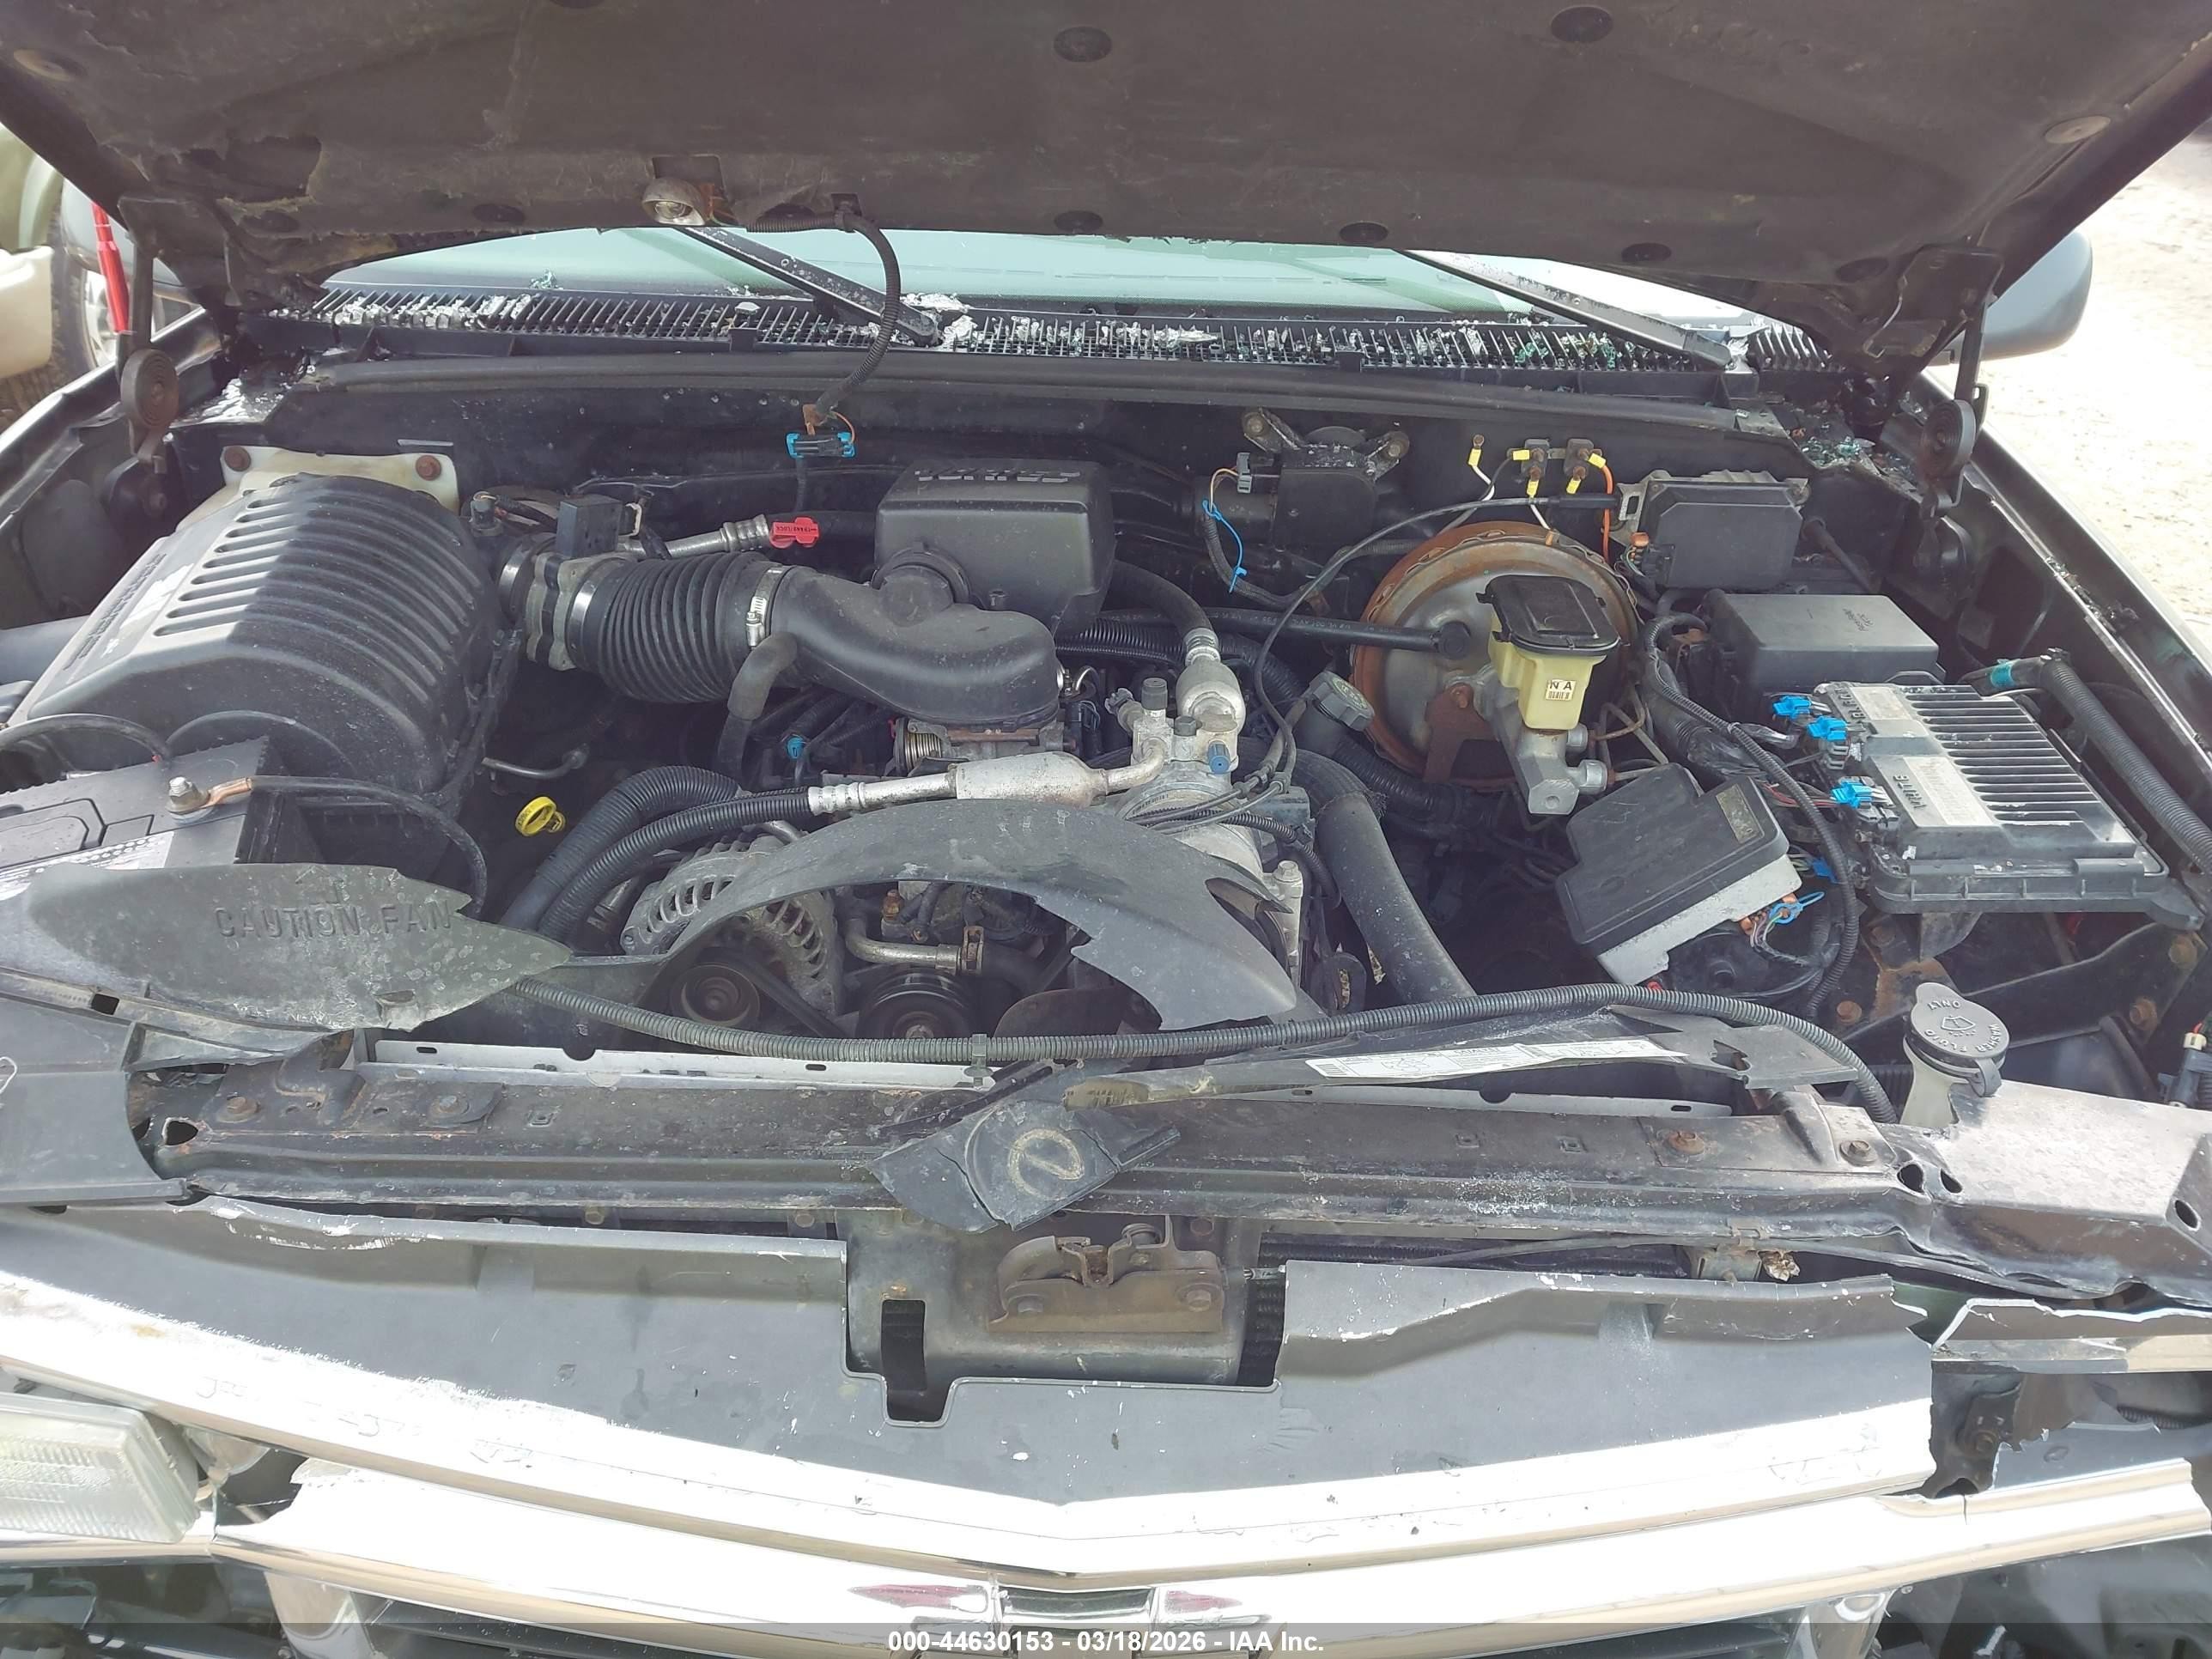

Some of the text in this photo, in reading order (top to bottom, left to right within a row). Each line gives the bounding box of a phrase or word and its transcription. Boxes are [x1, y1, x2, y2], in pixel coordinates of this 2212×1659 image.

[215, 900, 452, 938] CAUTION FAN
[1923, 1000, 2002, 1053] WASHER FLUID ONLY
